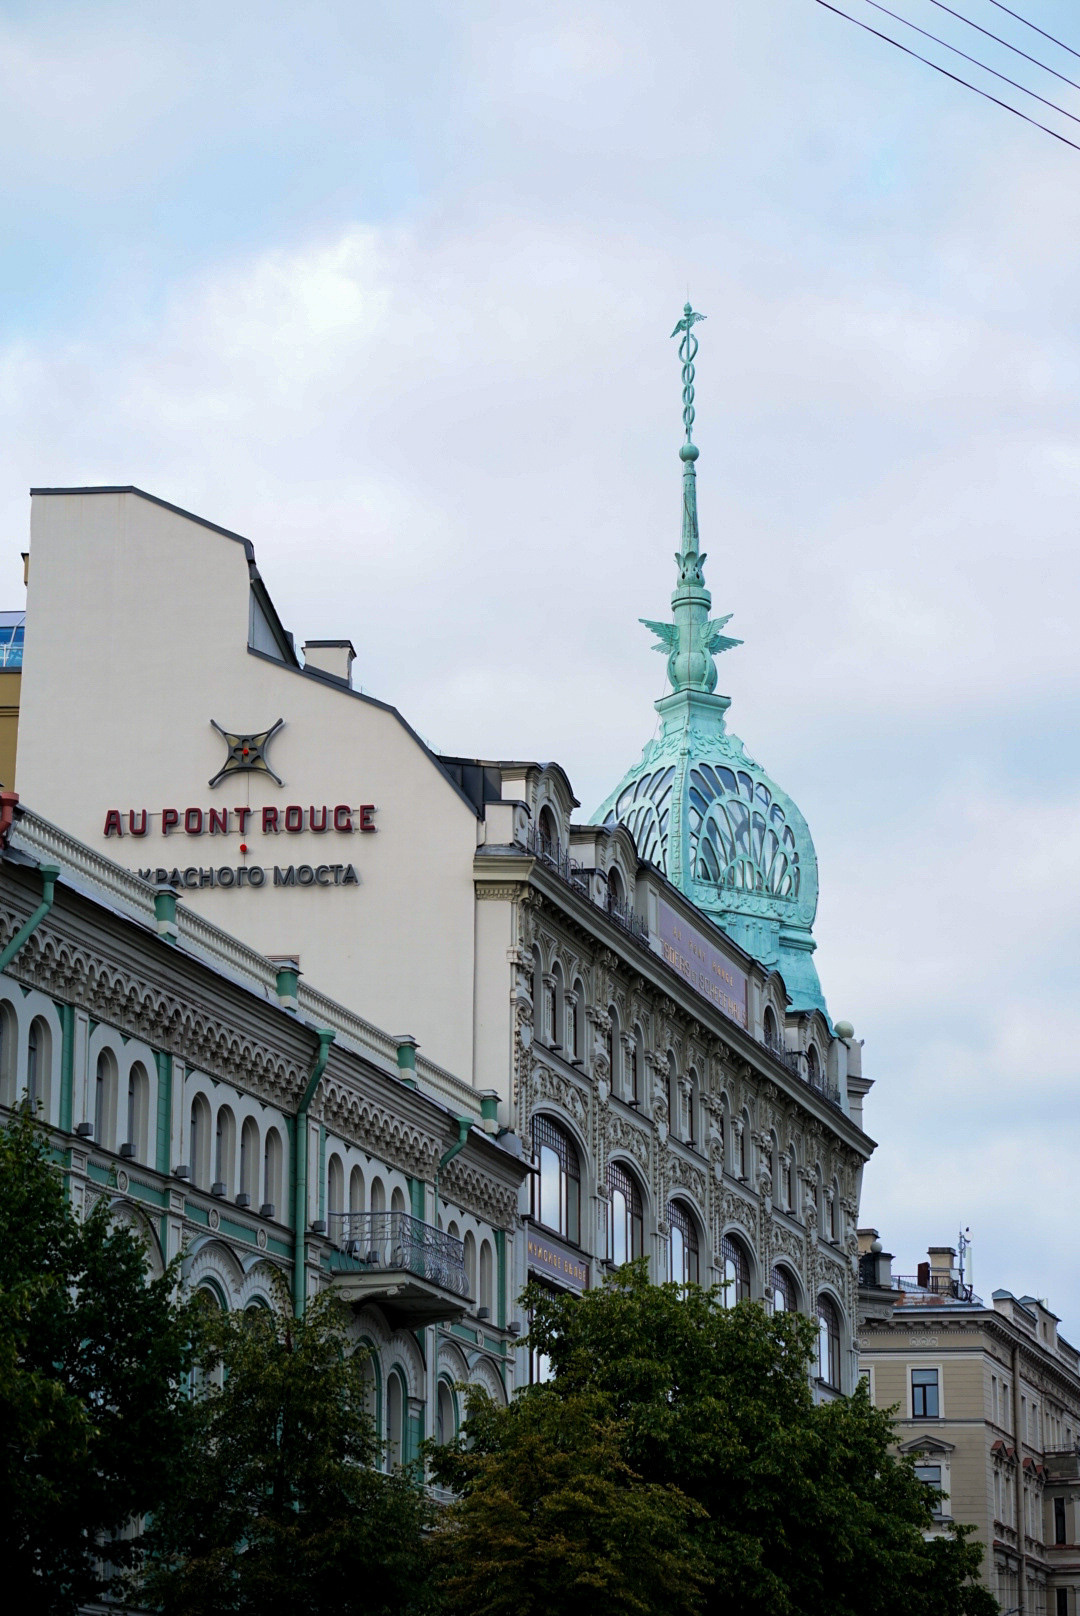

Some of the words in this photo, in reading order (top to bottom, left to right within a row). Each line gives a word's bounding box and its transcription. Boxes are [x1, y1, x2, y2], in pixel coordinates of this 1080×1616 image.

[103, 809, 148, 838] AU
[161, 807, 253, 837] PONT
[261, 804, 378, 835] ROUGE
[273, 863, 360, 887] МОСТА
